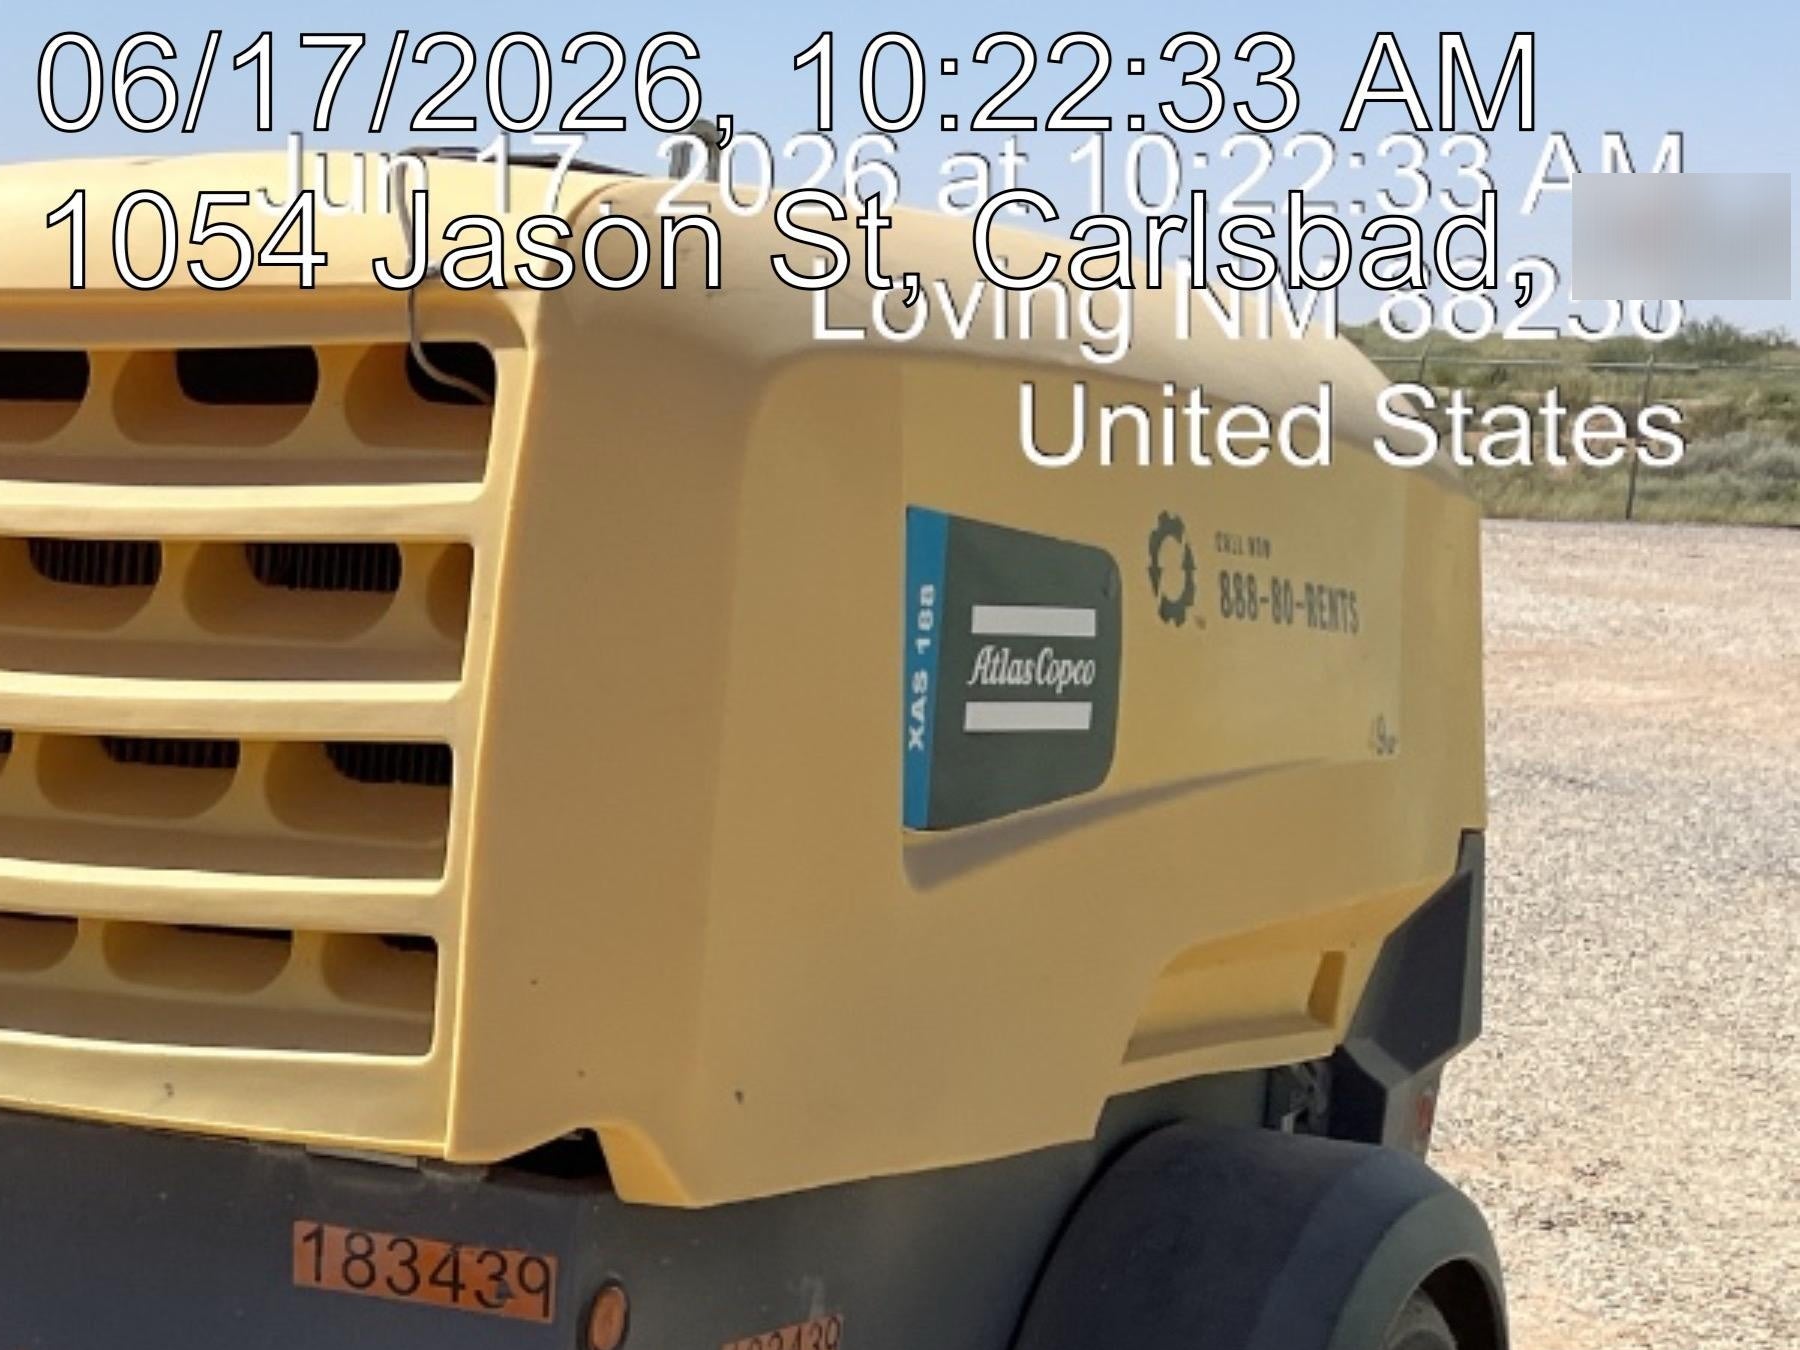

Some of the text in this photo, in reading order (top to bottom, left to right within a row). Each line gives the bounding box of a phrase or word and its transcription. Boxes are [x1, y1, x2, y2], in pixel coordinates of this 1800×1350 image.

[1218, 569, 1360, 636] 888-80-RENTS
[908, 669, 929, 752] XAS
[301, 1223, 553, 1320] 183439
